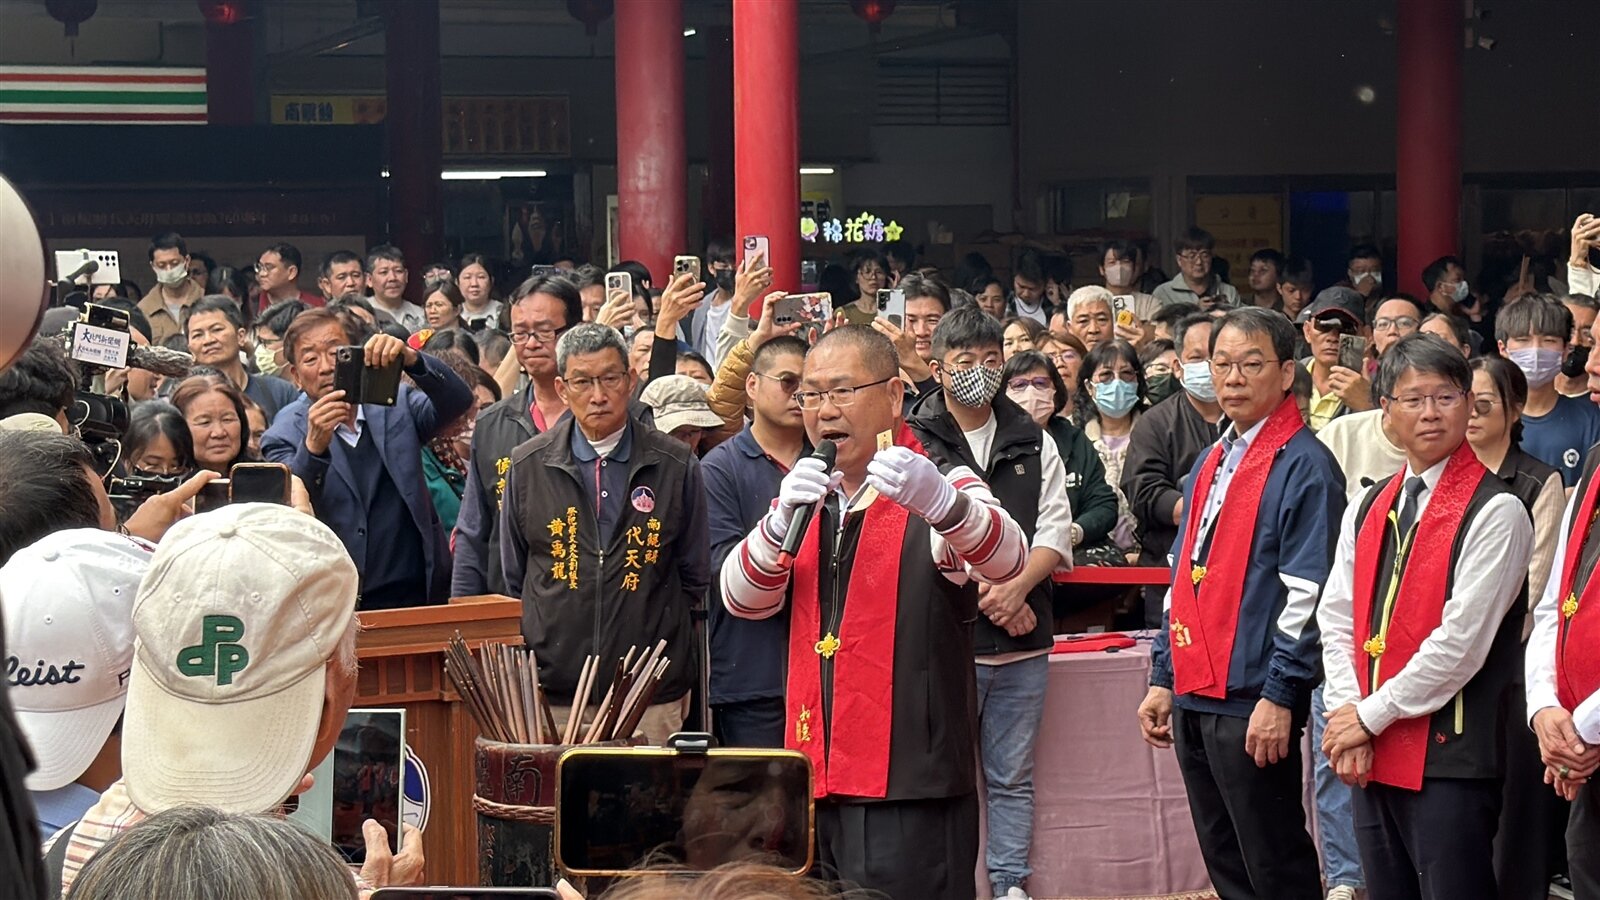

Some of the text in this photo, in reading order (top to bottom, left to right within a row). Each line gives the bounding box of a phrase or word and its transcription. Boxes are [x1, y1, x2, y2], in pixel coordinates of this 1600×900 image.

[822, 215, 885, 243] 棉花糖
[620, 526, 645, 592] 代天府
